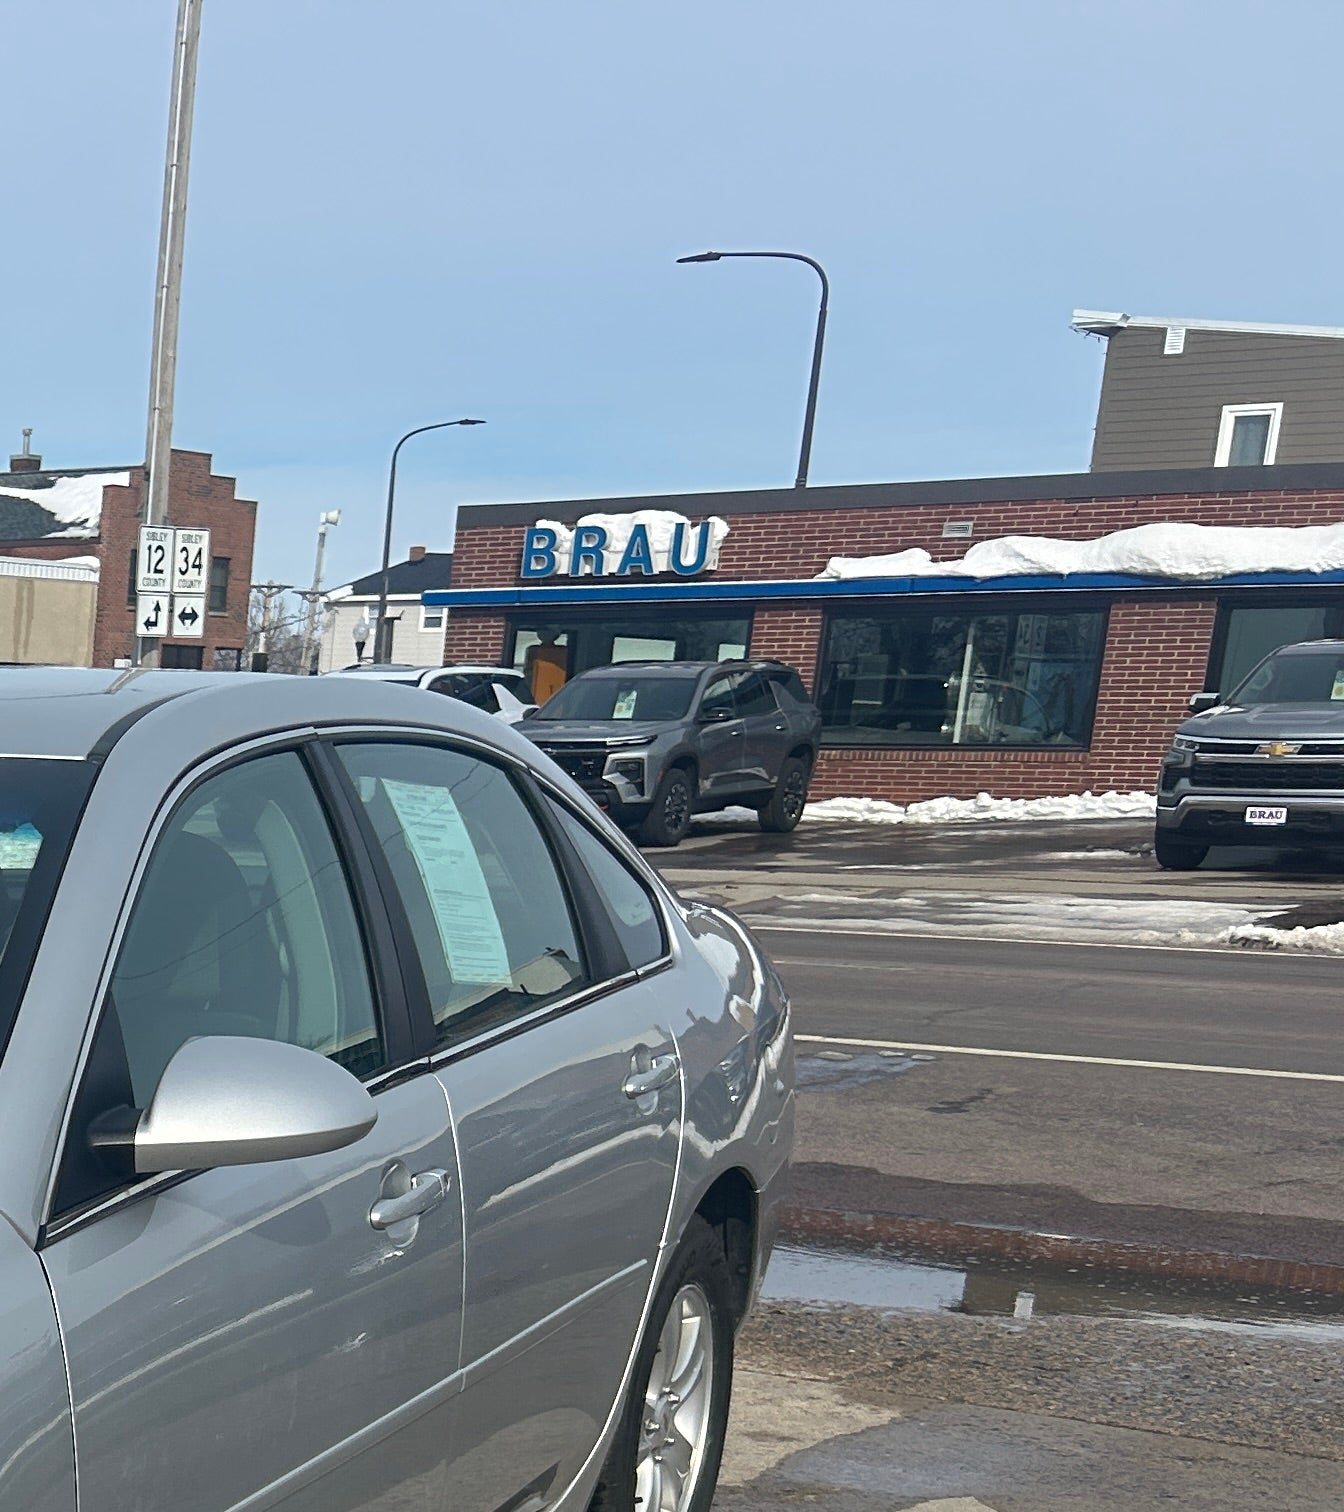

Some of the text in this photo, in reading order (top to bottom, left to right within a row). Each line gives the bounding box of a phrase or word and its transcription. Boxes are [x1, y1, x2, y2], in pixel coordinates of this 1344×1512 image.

[147, 544, 165, 574] 12
[178, 546, 203, 576] 34
[520, 521, 711, 578] BRAU
[142, 577, 166, 587] COUNTY
[1249, 810, 1283, 819] BRAU
